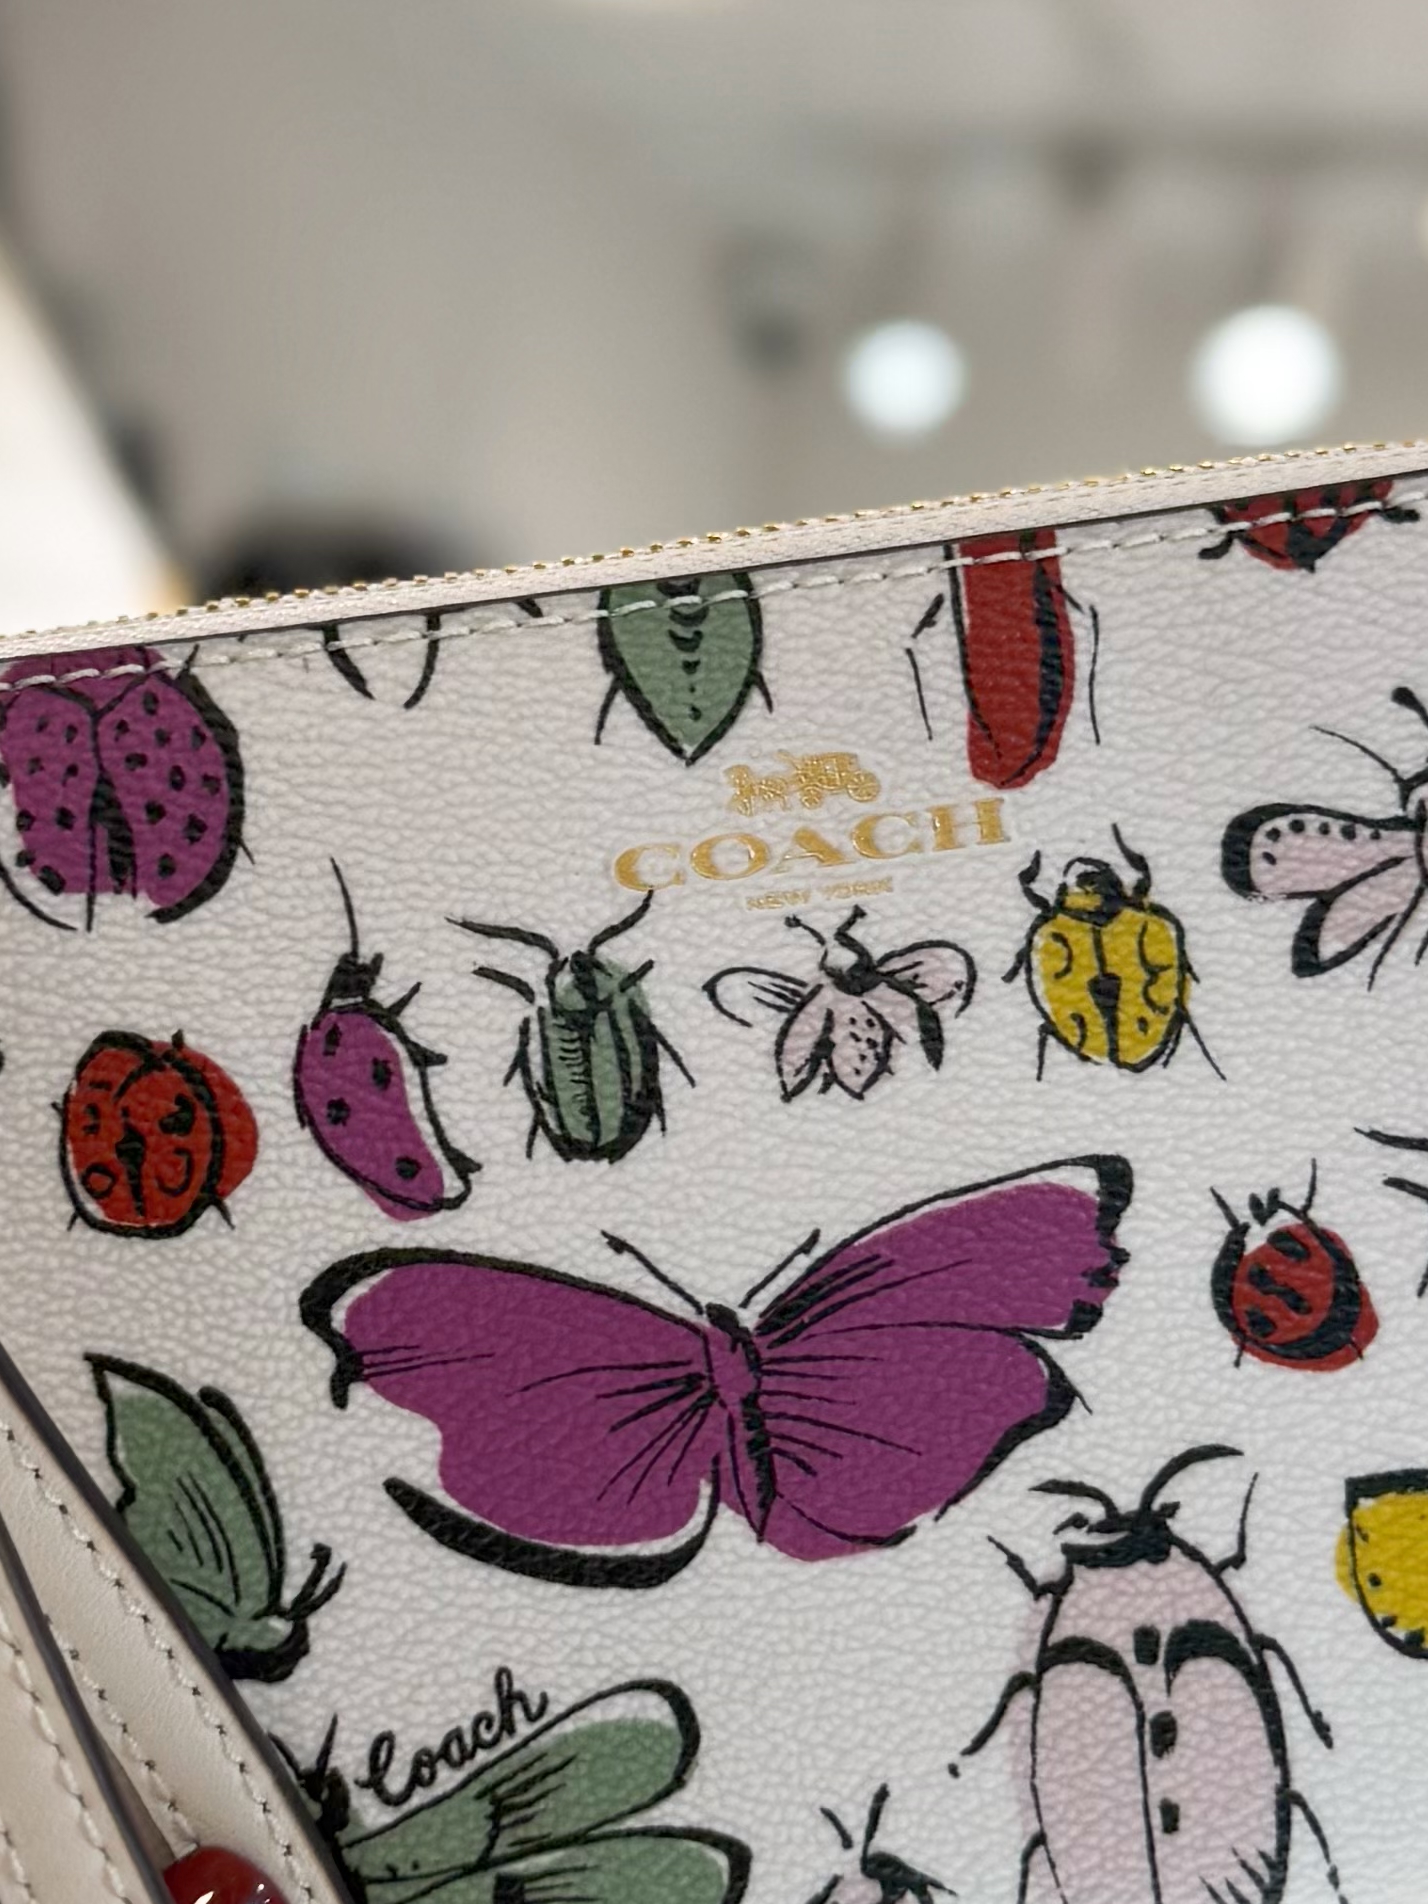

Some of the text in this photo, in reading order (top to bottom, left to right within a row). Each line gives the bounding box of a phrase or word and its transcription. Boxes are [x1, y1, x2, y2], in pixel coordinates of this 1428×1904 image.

[613, 796, 1011, 893] COACH
[746, 887, 812, 911] NEW
[353, 1665, 550, 1808] Coach
